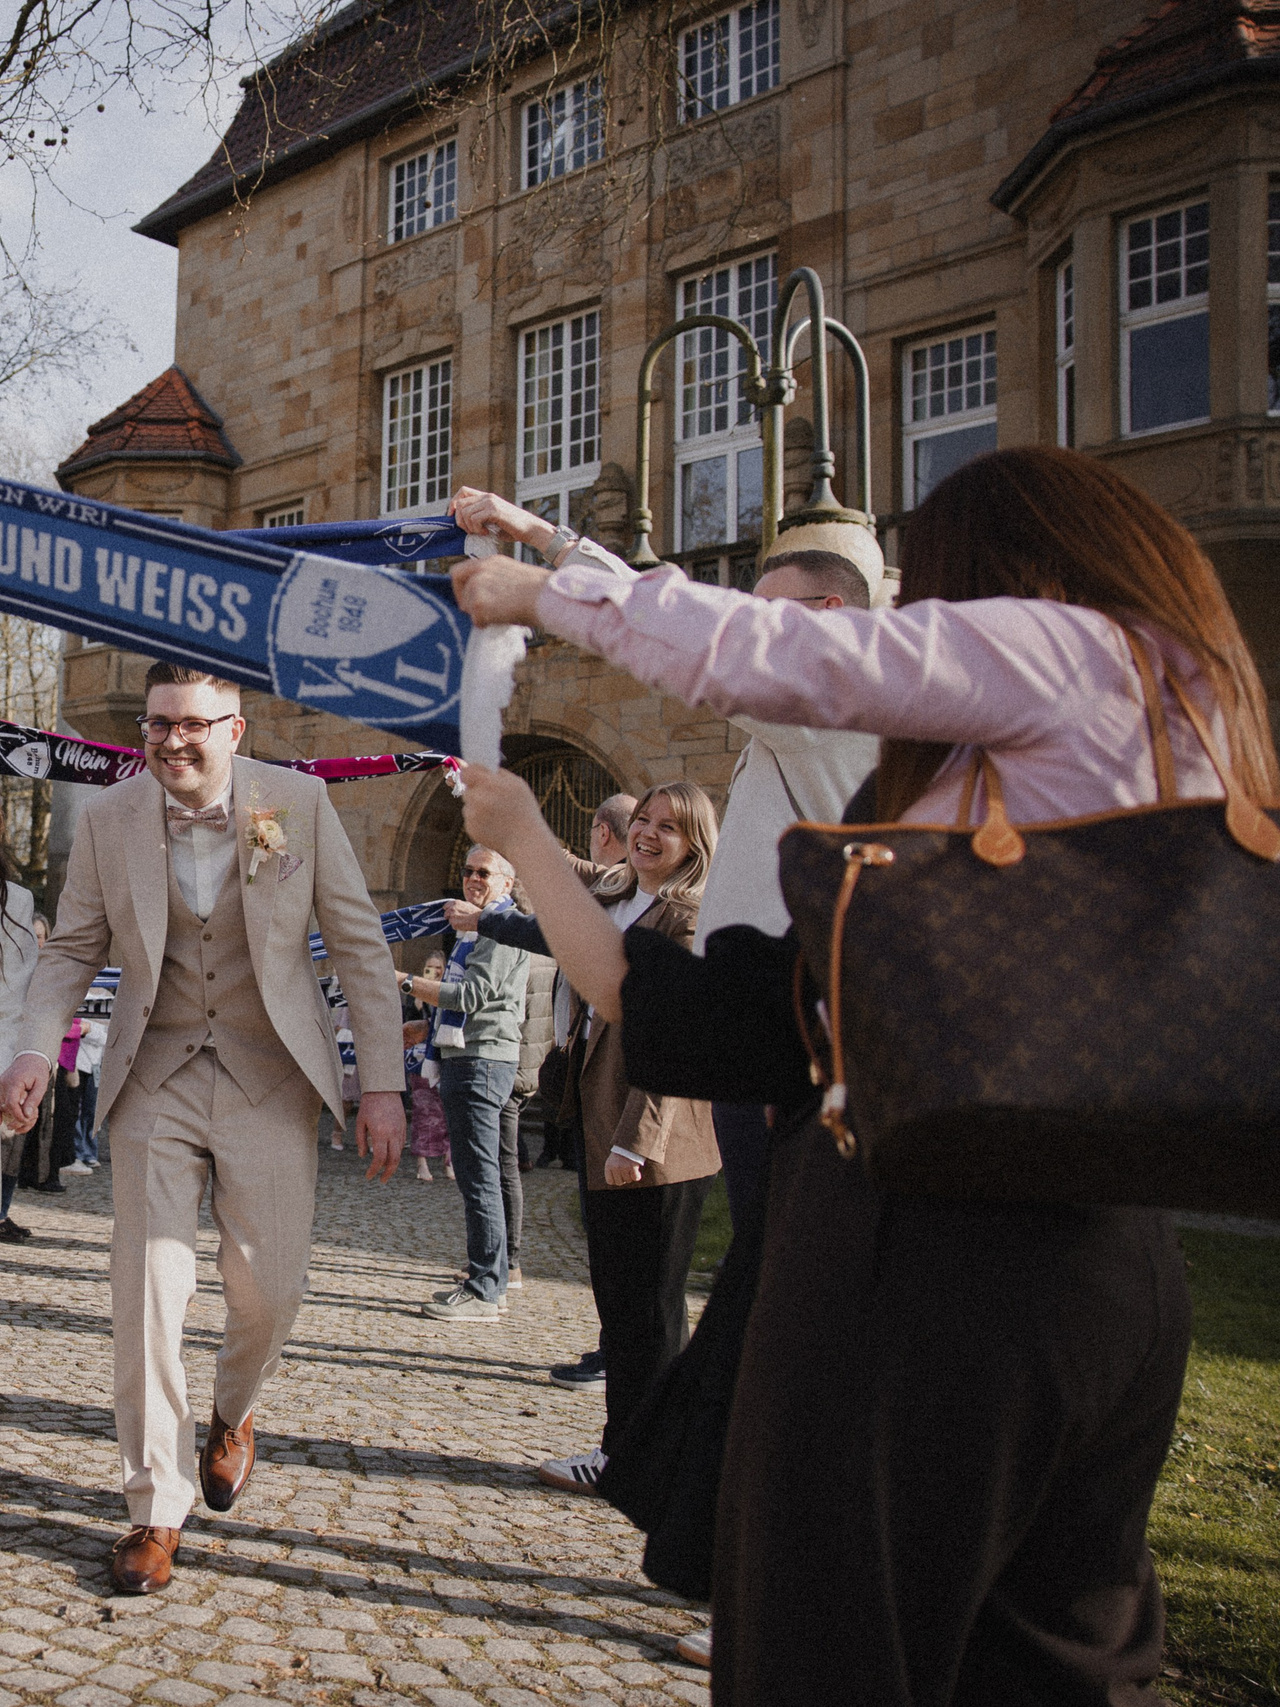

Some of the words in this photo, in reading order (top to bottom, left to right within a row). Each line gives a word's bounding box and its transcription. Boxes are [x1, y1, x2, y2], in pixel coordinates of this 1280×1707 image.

[33, 491, 108, 527] WIR!
[95, 547, 252, 643] WEISS
[297, 642, 452, 708] VfL
[54, 739, 111, 772] Mein
